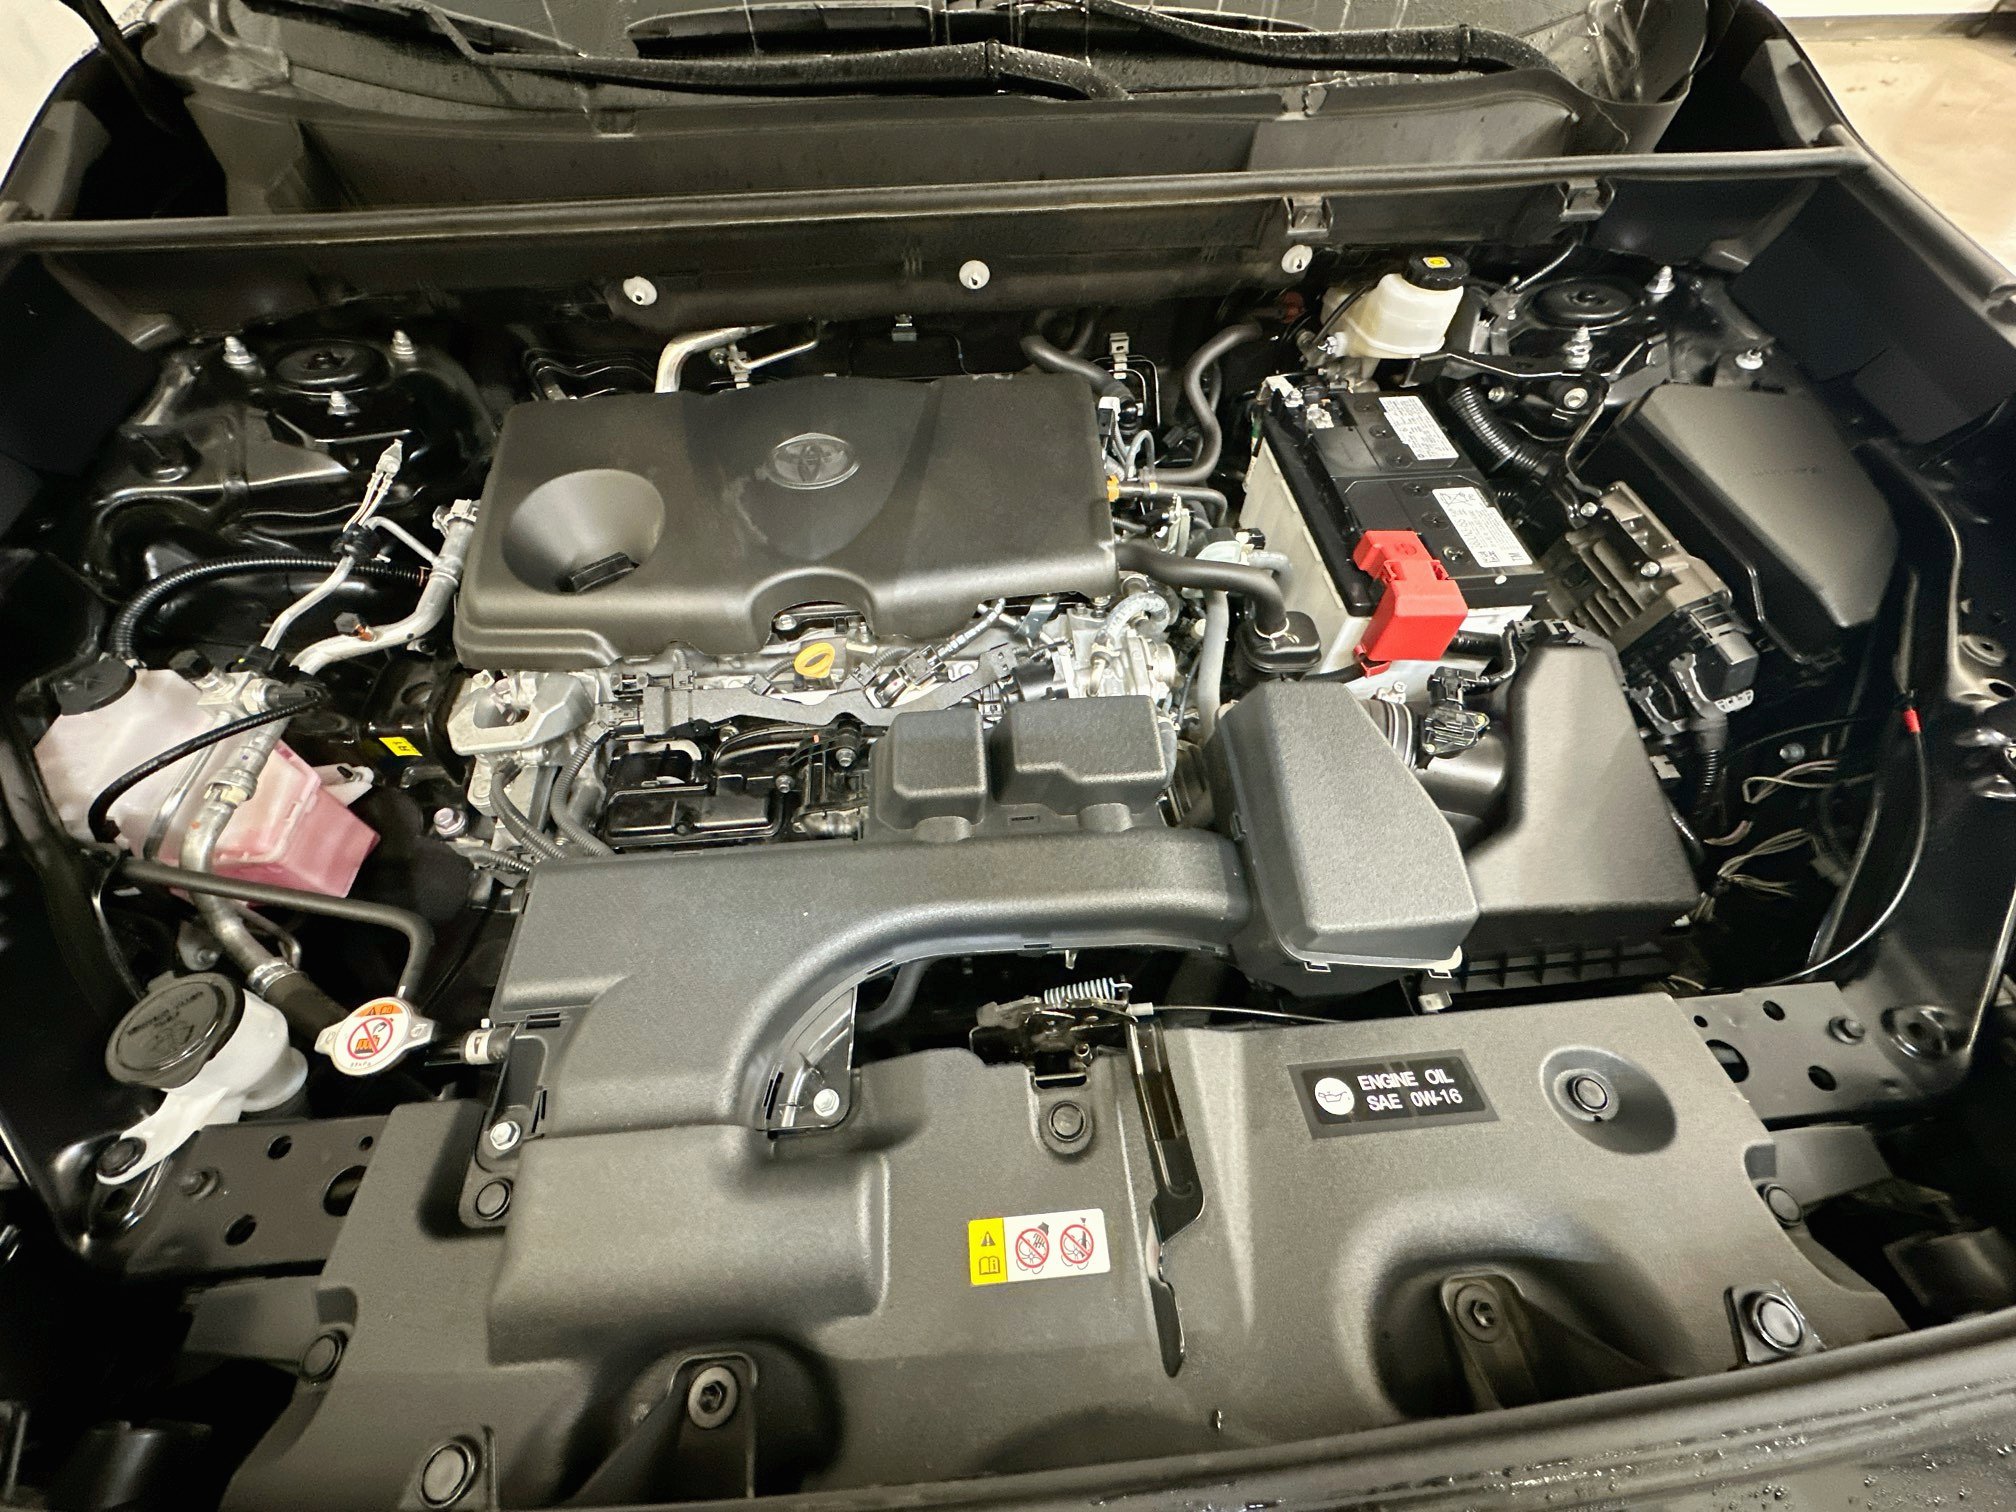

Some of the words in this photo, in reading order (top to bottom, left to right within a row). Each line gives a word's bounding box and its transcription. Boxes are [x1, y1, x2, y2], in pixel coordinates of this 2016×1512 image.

[1357, 1071, 1418, 1091] ENGINE
[1424, 1068, 1454, 1085] OIL
[1366, 1094, 1403, 1112] SAE
[1410, 1088, 1463, 1108] 0W-16
